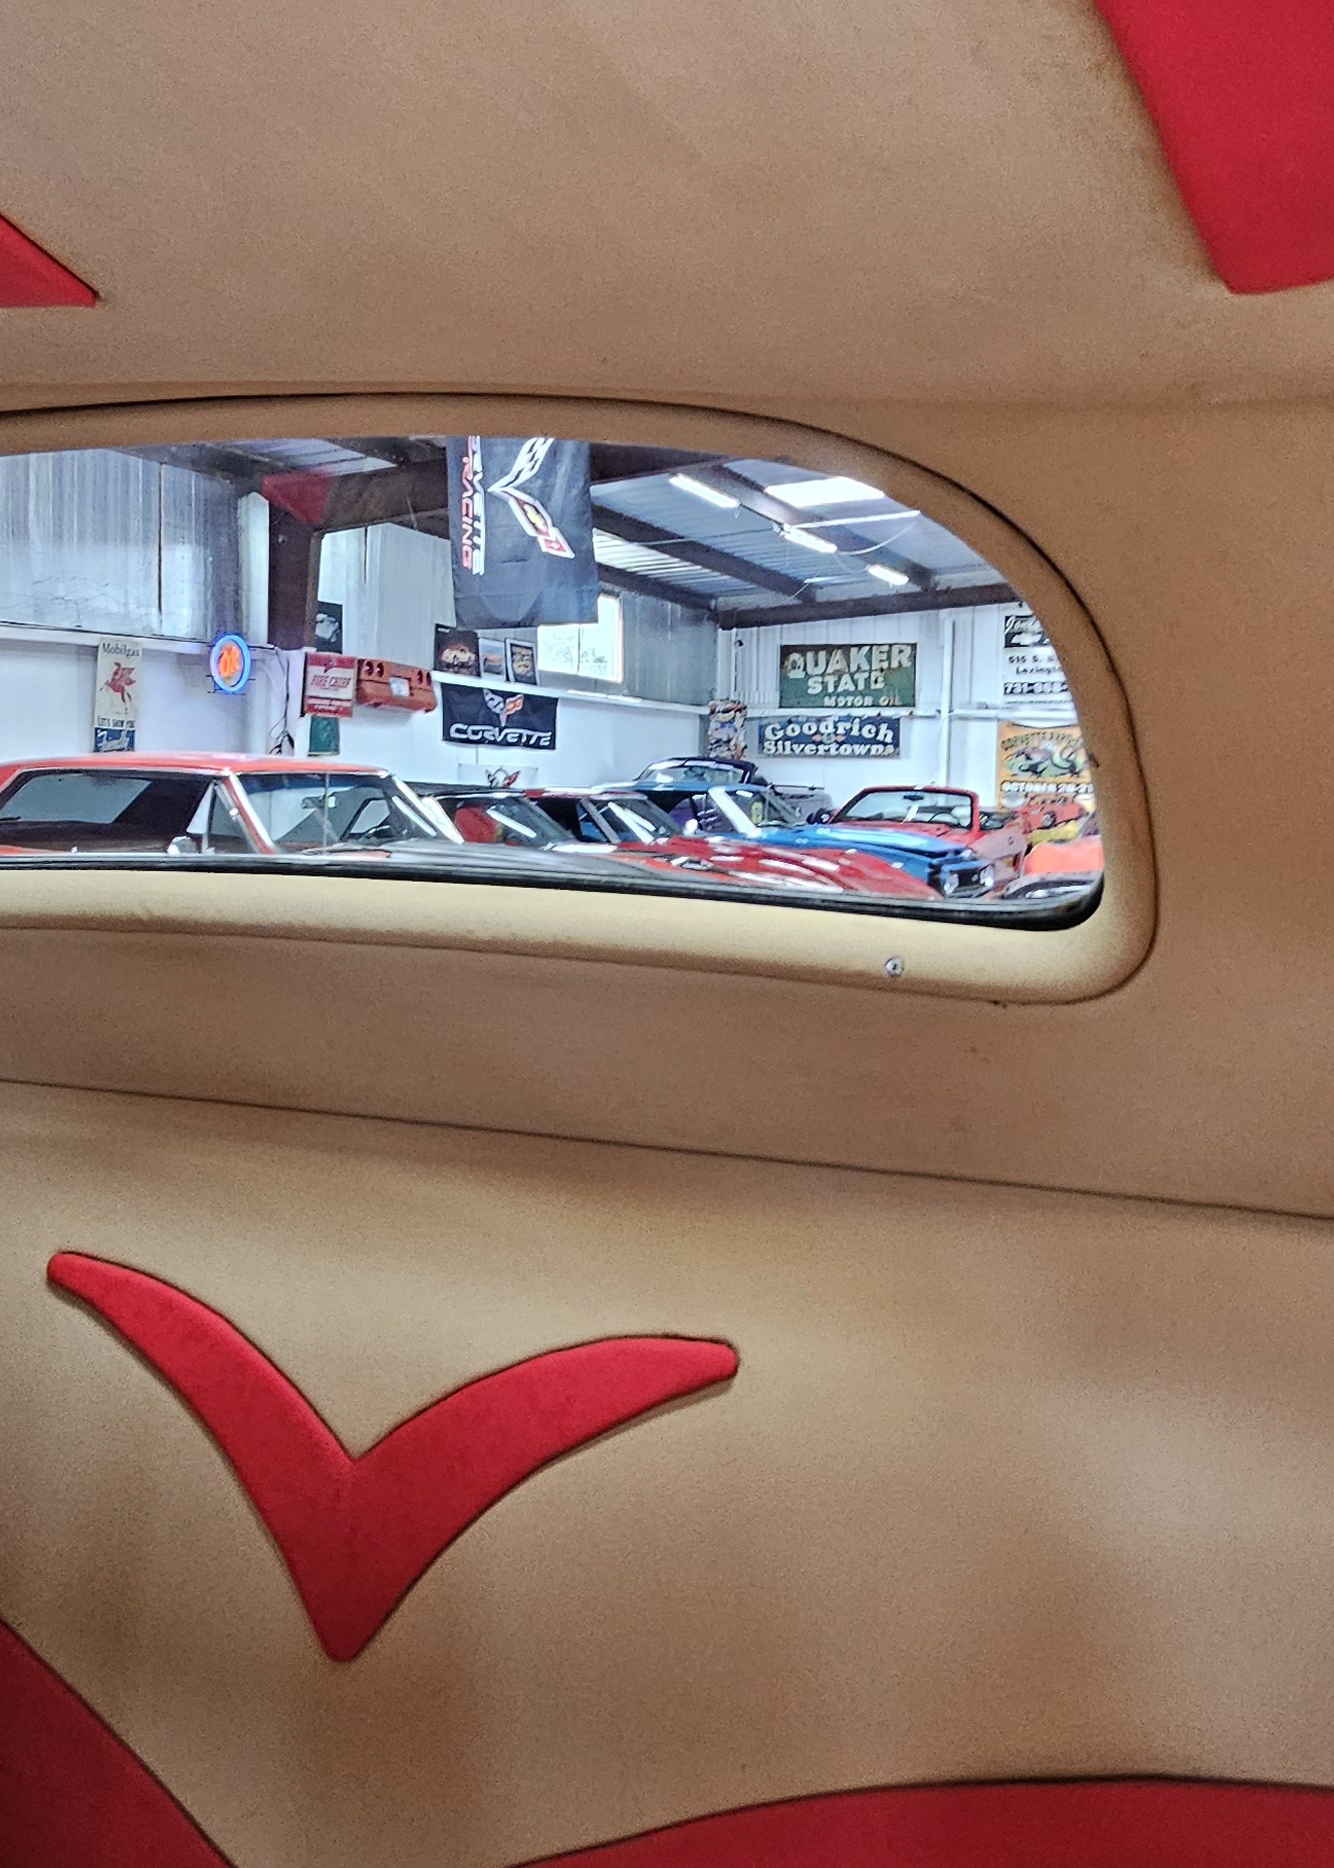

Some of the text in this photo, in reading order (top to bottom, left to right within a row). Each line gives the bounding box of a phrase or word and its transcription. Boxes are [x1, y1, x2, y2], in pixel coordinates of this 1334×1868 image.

[102, 642, 140, 657] Mobilgas
[785, 645, 912, 679] QUAKER
[807, 670, 885, 695] STATE
[823, 695, 903, 708] MOTOR OIL
[449, 722, 553, 747] CORVETTE
[764, 717, 894, 744] Goodrich
[762, 739, 895, 757] Silvertowns
